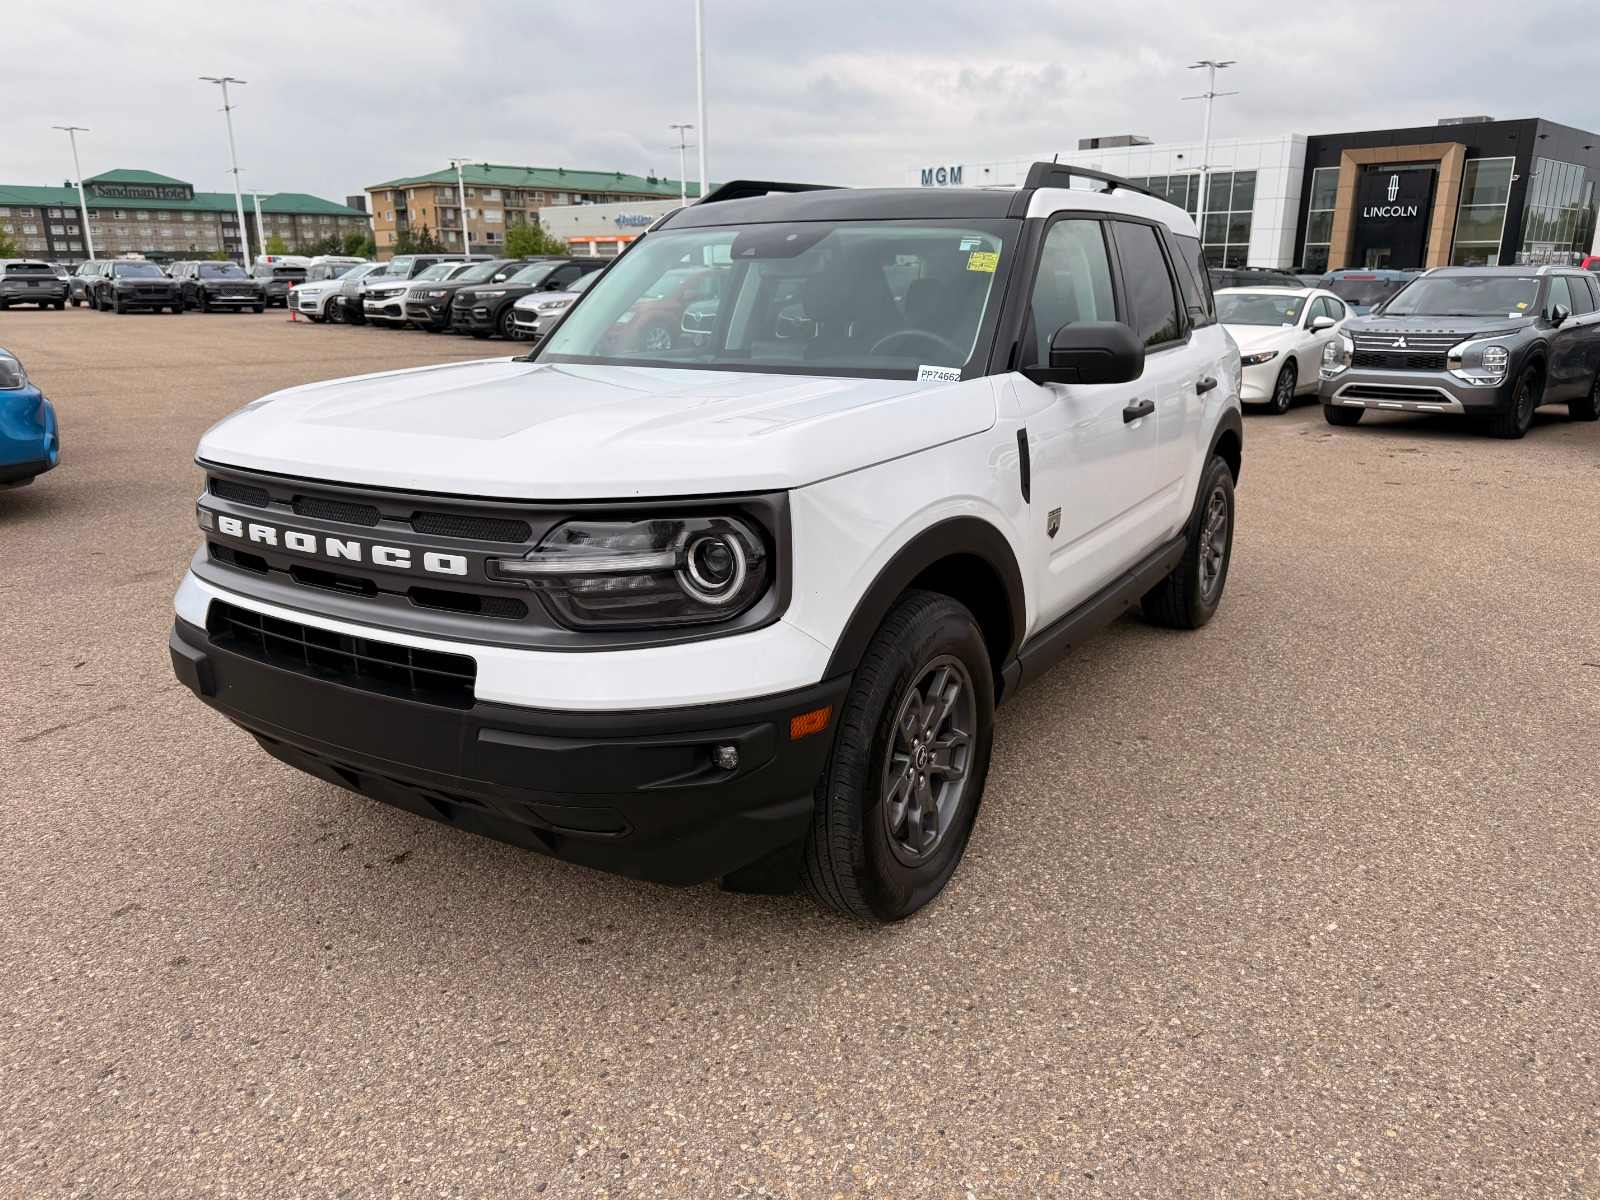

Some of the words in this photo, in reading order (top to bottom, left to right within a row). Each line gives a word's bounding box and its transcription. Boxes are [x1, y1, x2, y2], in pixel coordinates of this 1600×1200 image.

[921, 166, 962, 185] MGM
[97, 183, 156, 198] Sandman
[157, 186, 187, 199] Hotel
[1363, 205, 1418, 217] LINCOLN
[921, 370, 960, 381] PP74662
[218, 515, 468, 576] BRONCO
